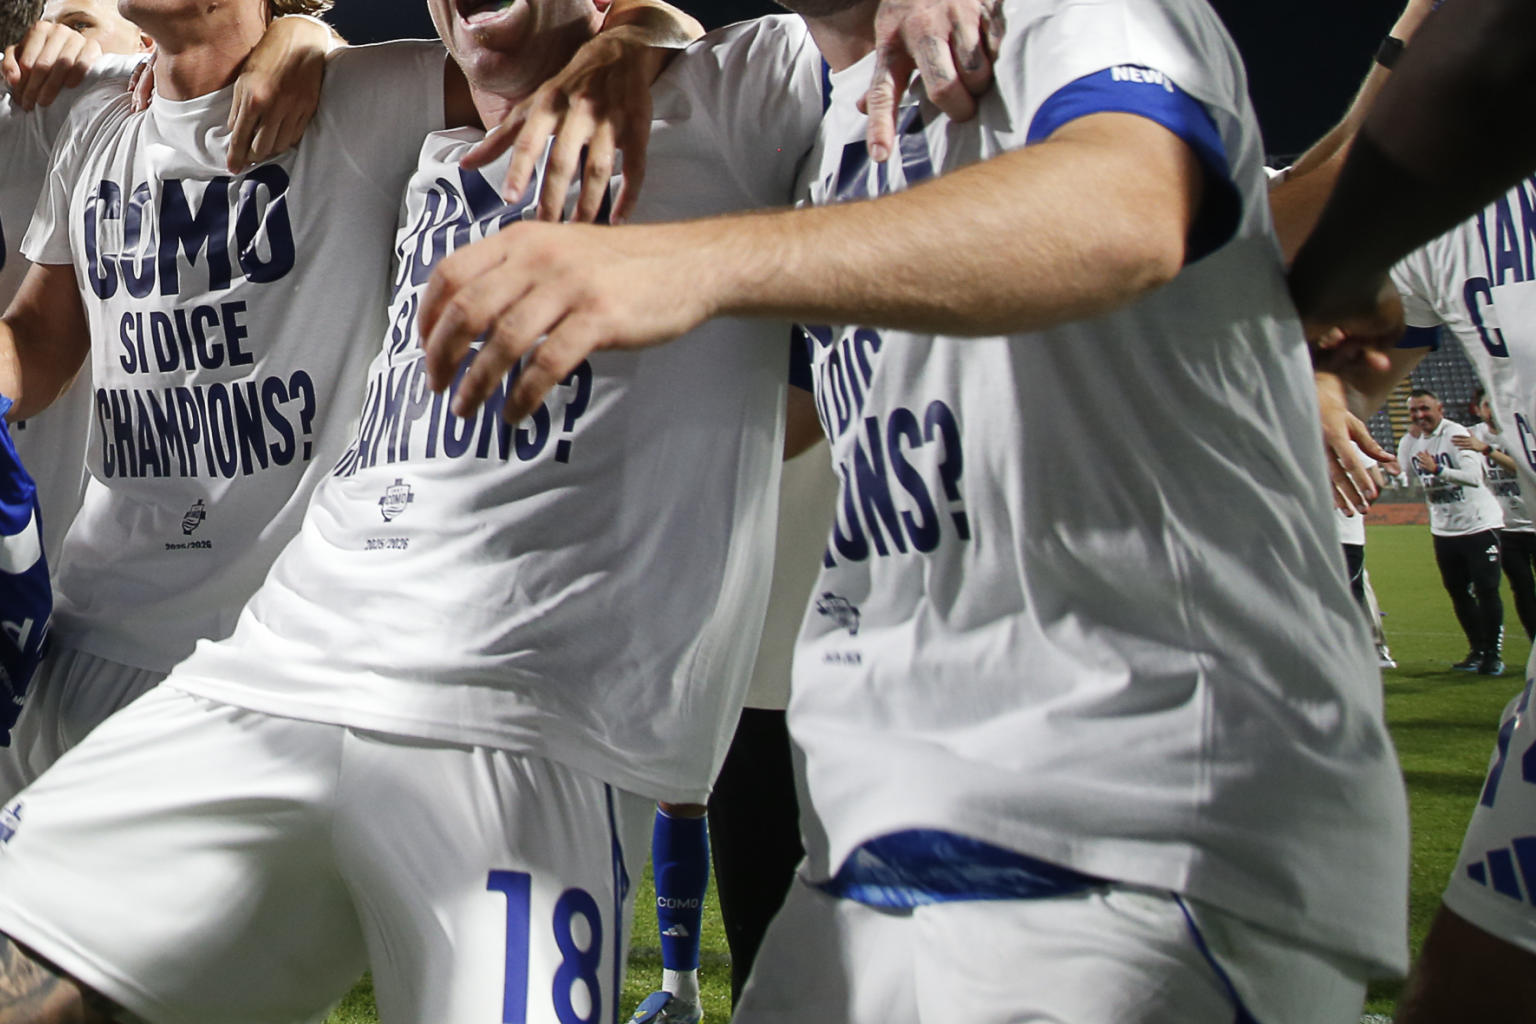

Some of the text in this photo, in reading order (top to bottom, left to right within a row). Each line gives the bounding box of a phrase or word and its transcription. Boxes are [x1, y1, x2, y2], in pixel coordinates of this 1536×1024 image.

[84, 163, 296, 300] COMO
[120, 300, 254, 374] SI DICE
[96, 369, 316, 478] CHAMPIONS?
[487, 869, 603, 1024] 18
[657, 896, 699, 909] COMO
